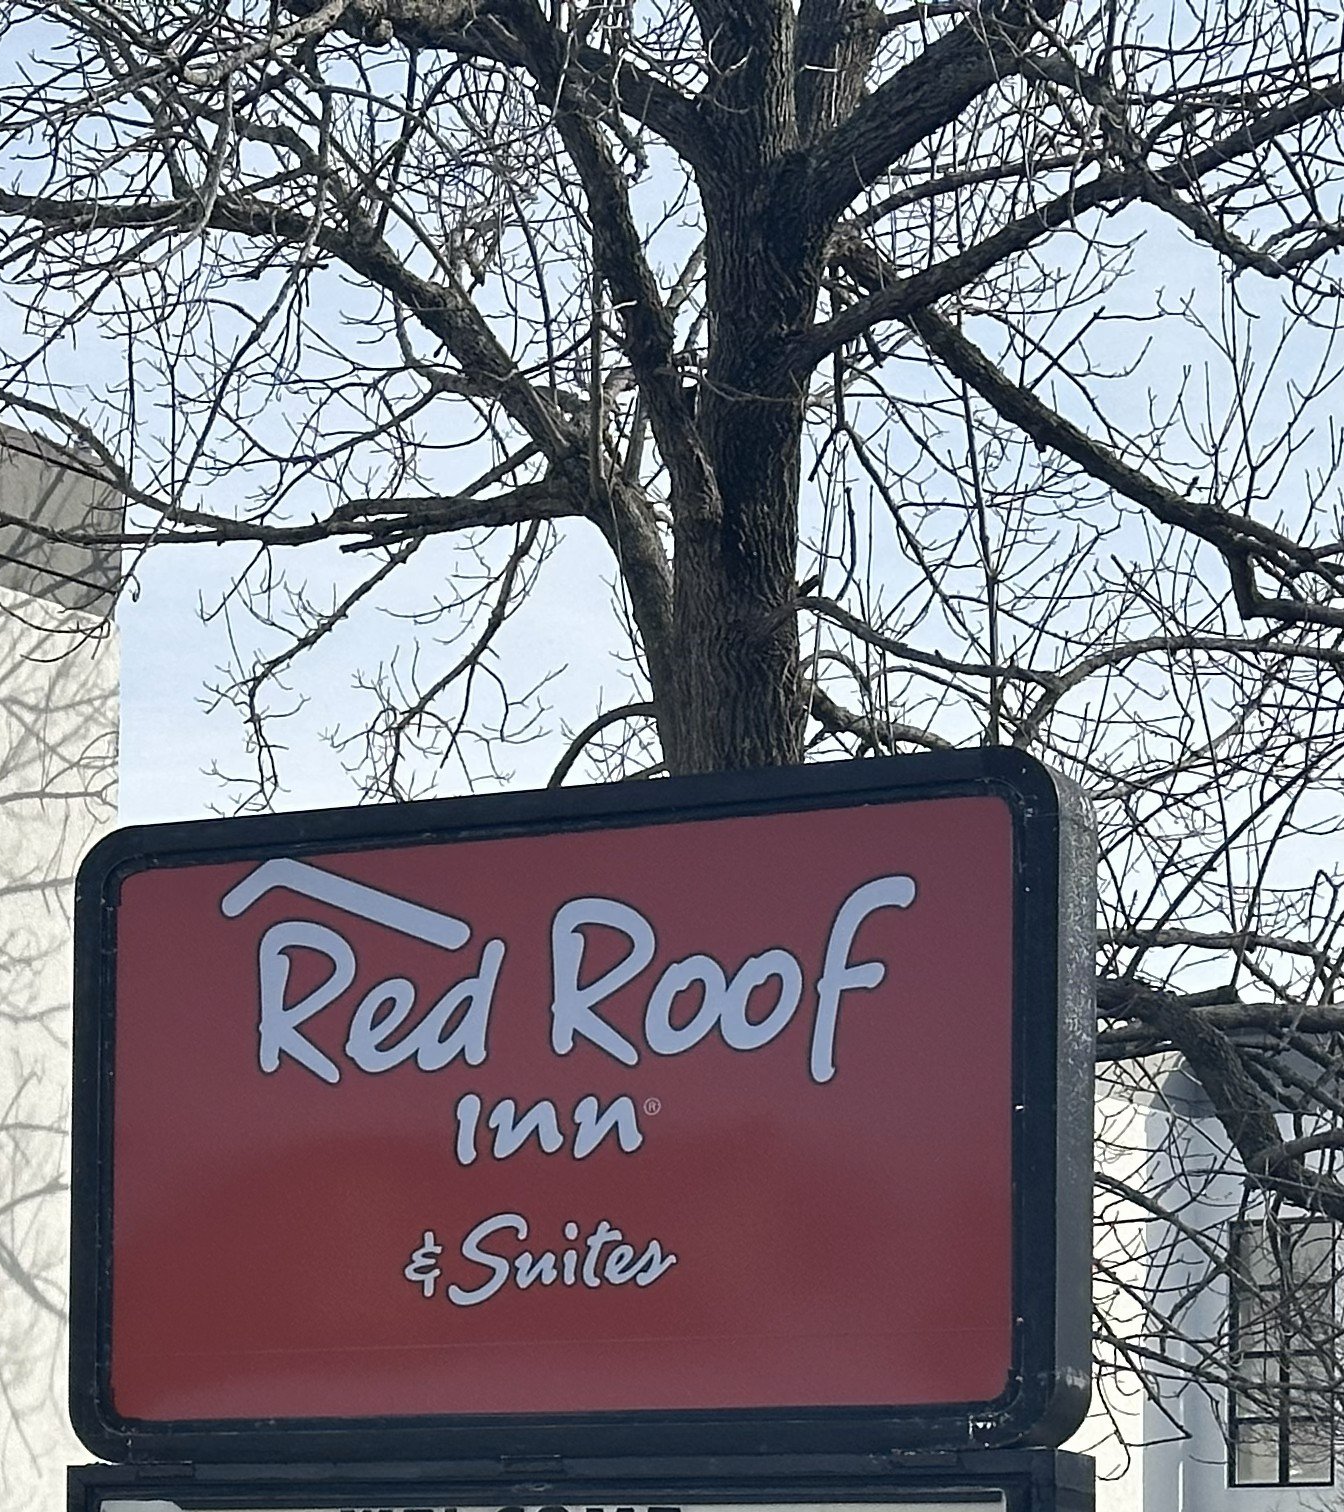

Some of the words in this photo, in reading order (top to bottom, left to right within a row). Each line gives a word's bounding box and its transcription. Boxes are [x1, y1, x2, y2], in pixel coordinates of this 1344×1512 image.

[257, 920, 507, 1084] Red
[550, 874, 918, 1084] Roof
[403, 1230, 443, 1298] &
[447, 1212, 678, 1307] Suites
